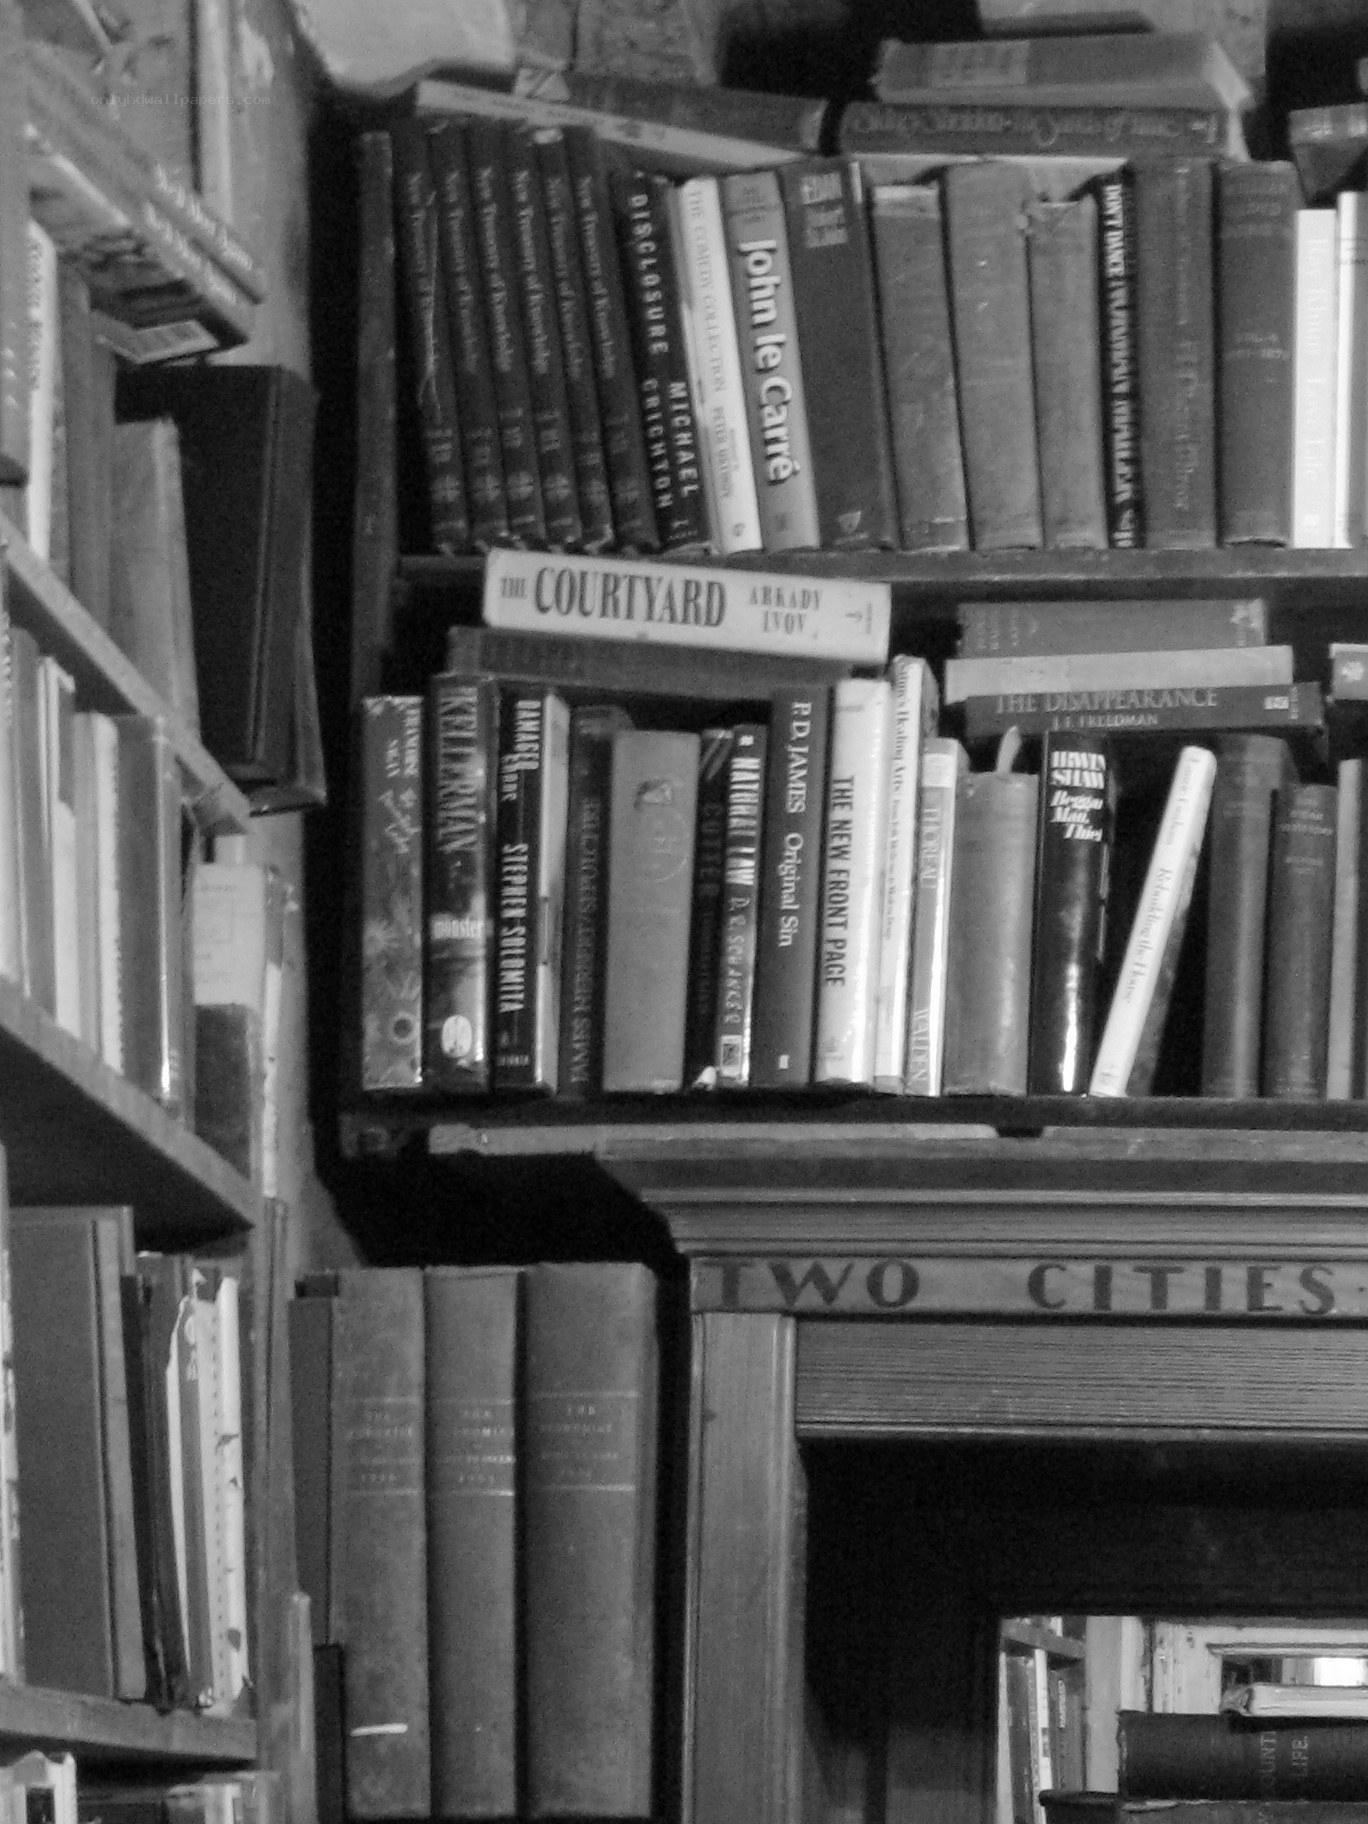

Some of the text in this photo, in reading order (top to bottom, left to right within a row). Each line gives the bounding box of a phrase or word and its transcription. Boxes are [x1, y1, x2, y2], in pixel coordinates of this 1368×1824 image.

[629, 194, 669, 355] DISCLOSURE
[688, 191, 727, 392] THE COMEDY COLLECTION
[1107, 230, 1125, 277] DANCE
[739, 240, 801, 481] John le Carré
[642, 379, 673, 509] CRICHTON
[669, 381, 699, 498] MICHAEL
[499, 565, 726, 629] THE COURTYARD
[747, 586, 824, 611] ARKADY
[515, 700, 541, 770] DAMAGED
[995, 687, 1218, 714] THE DISAPPEARANCE
[437, 688, 479, 855] KELLERMAN
[785, 746, 809, 813] JAMES
[1051, 770, 1105, 789] SHAW
[726, 757, 760, 886] NATURAL LAW
[920, 806, 939, 889] THOREAU
[777, 832, 804, 947] Original Sin
[823, 776, 854, 987] THE NEW FRONT PAGE
[499, 843, 529, 1013] STEPHEN SOLOMITA
[569, 1017, 591, 1083] JAMES
[912, 1007, 929, 1082] WALDEN
[701, 1258, 922, 1310] TWO
[1027, 1261, 1337, 1315] CITIES
